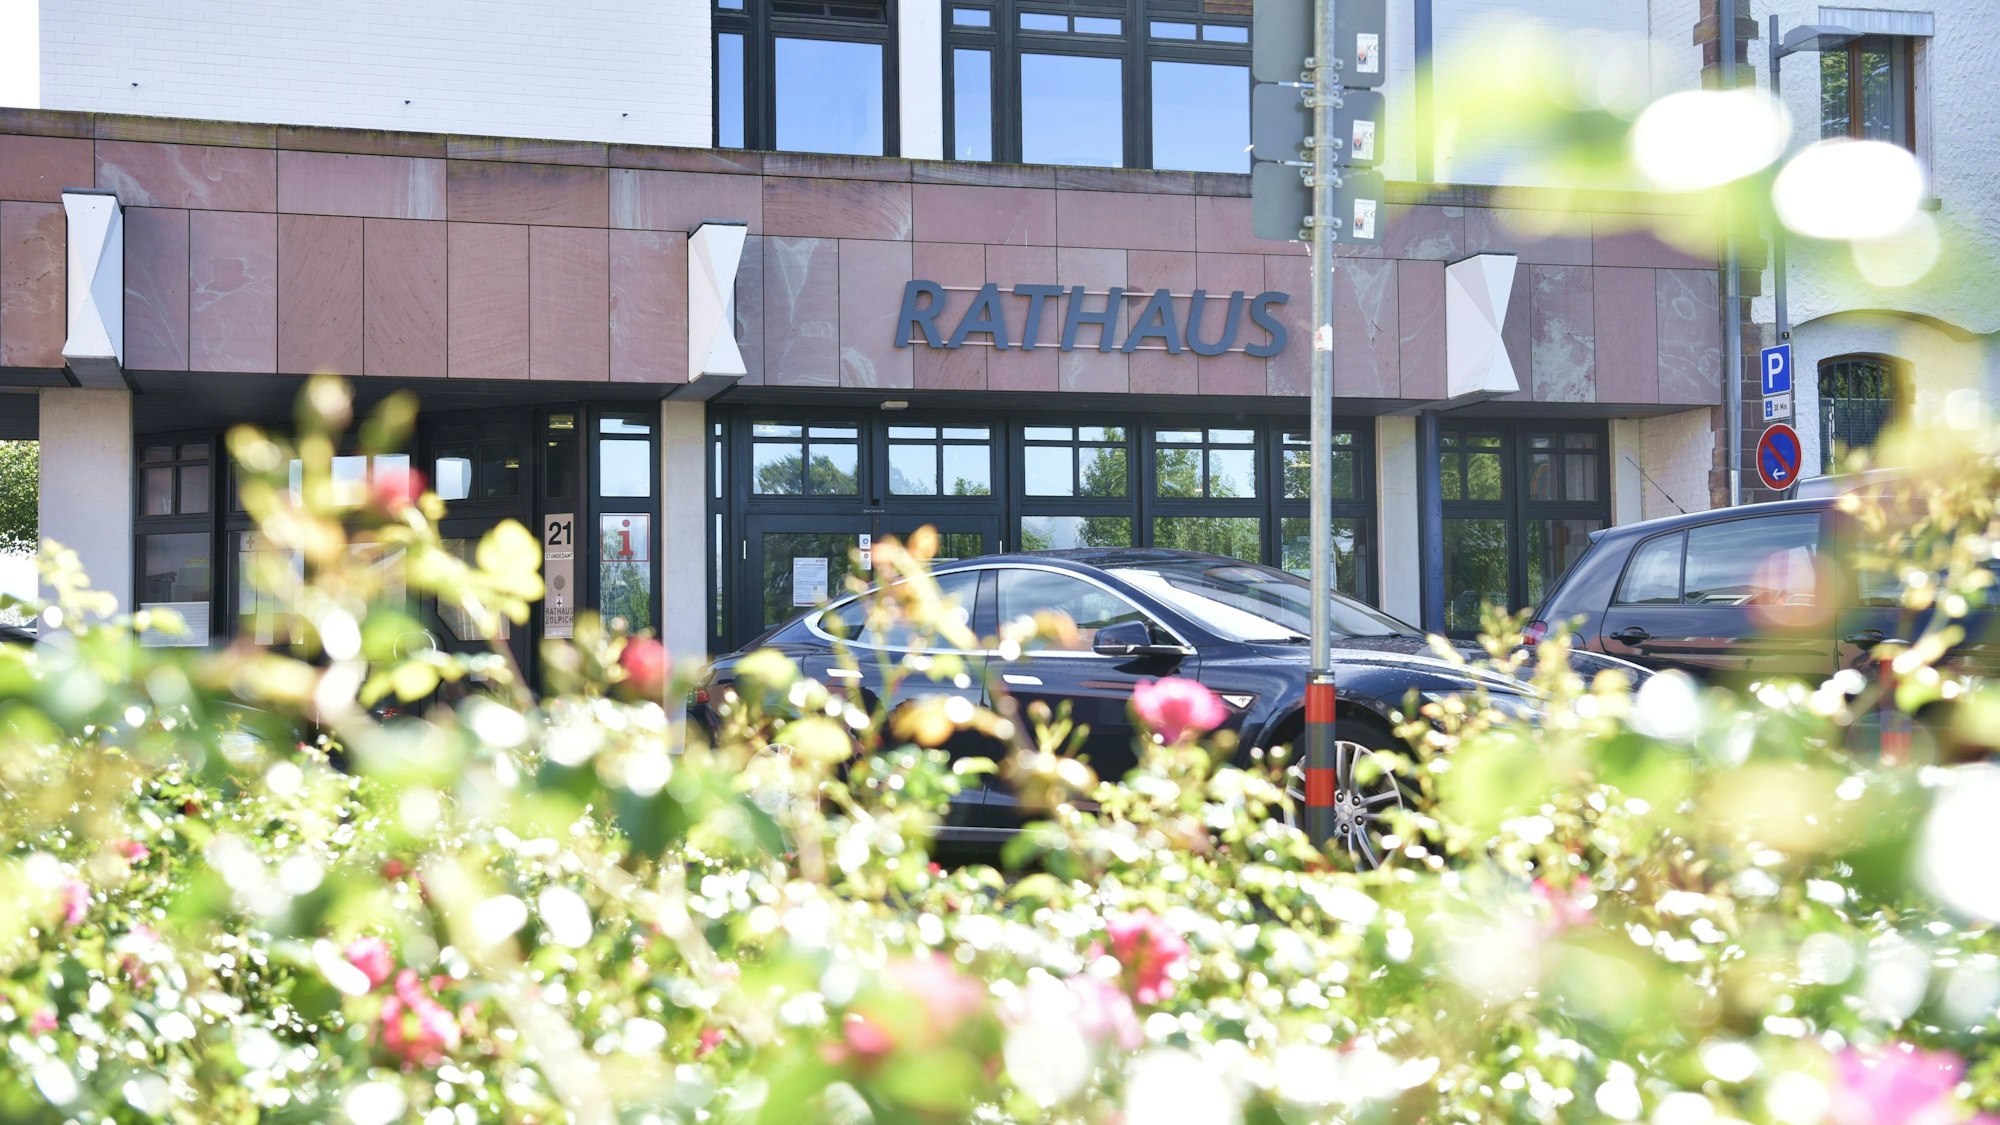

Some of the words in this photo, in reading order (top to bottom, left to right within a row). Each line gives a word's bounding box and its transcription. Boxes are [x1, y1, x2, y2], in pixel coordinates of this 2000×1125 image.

[895, 280, 1290, 357] RATHAUS
[1768, 352, 1784, 389] P
[548, 521, 571, 546] 21
[545, 607, 573, 616] RATHAUS
